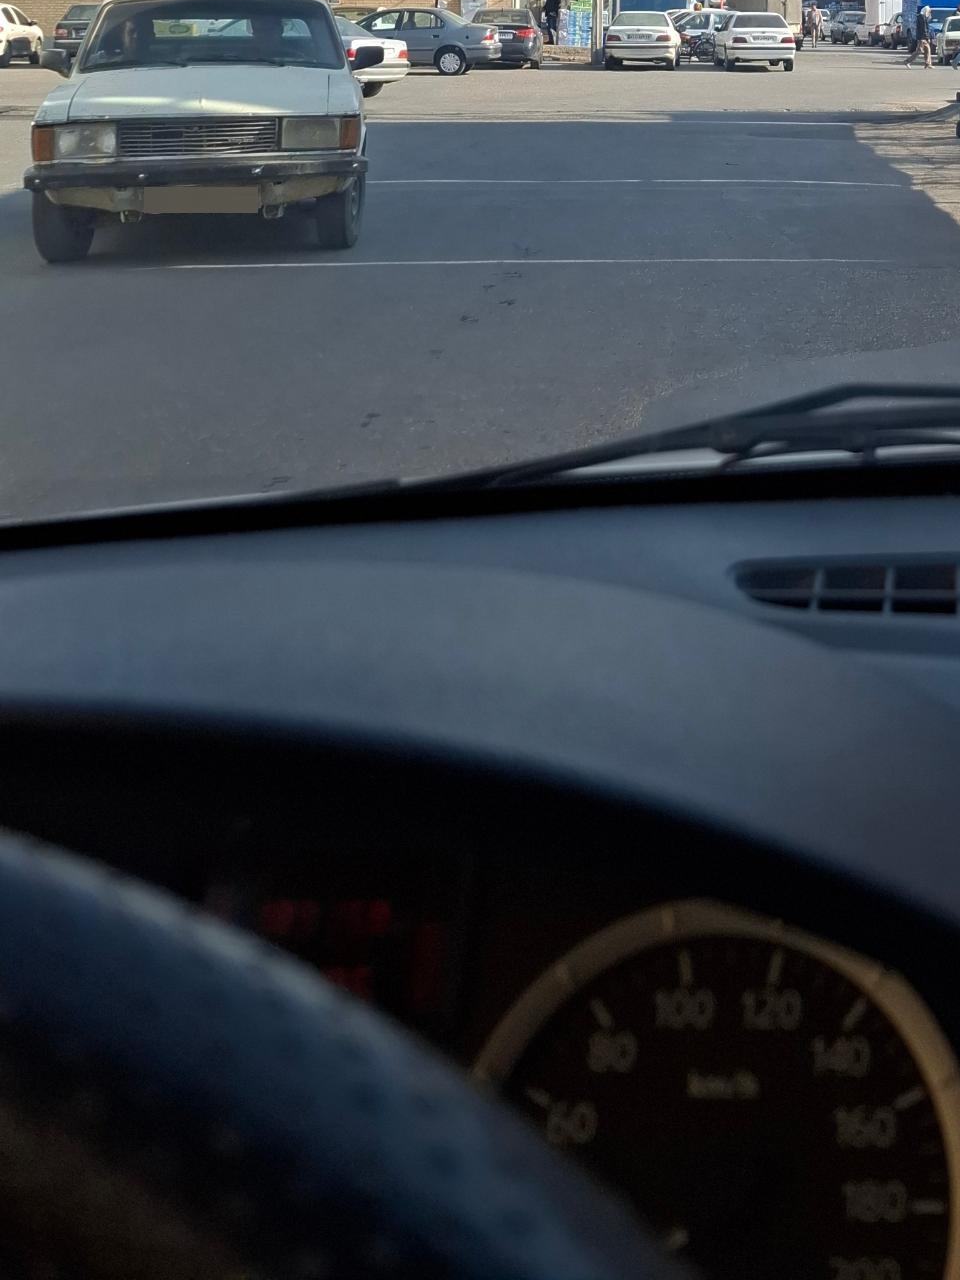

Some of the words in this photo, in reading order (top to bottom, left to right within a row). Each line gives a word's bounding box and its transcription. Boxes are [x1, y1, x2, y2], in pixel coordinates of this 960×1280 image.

[655, 990, 716, 1031] 100
[742, 988, 805, 1033] 120
[813, 1034, 875, 1077] 140
